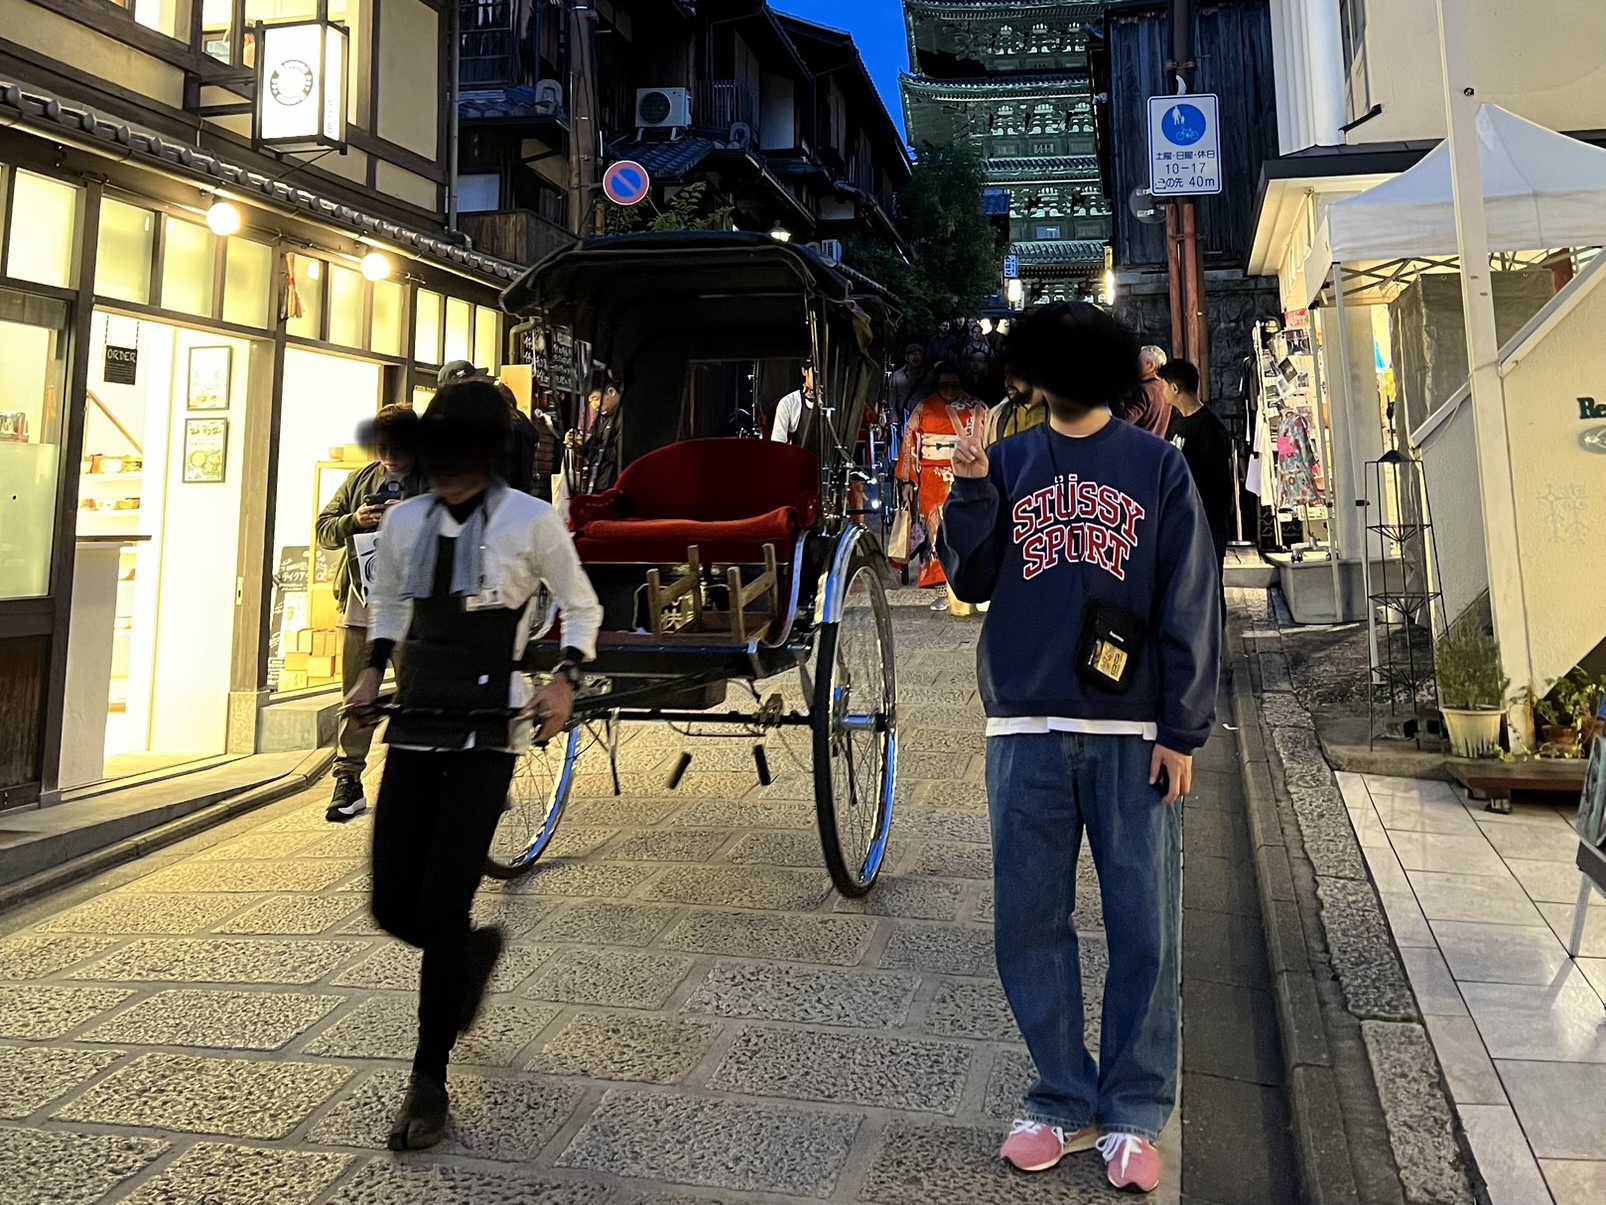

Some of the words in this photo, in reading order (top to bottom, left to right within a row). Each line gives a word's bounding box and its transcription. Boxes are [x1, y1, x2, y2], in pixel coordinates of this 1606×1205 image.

[1189, 175, 1215, 188] 40m
[107, 348, 136, 363] ORDER
[1012, 473, 1145, 547] STÜSSY
[1023, 522, 1131, 581] SPORT
